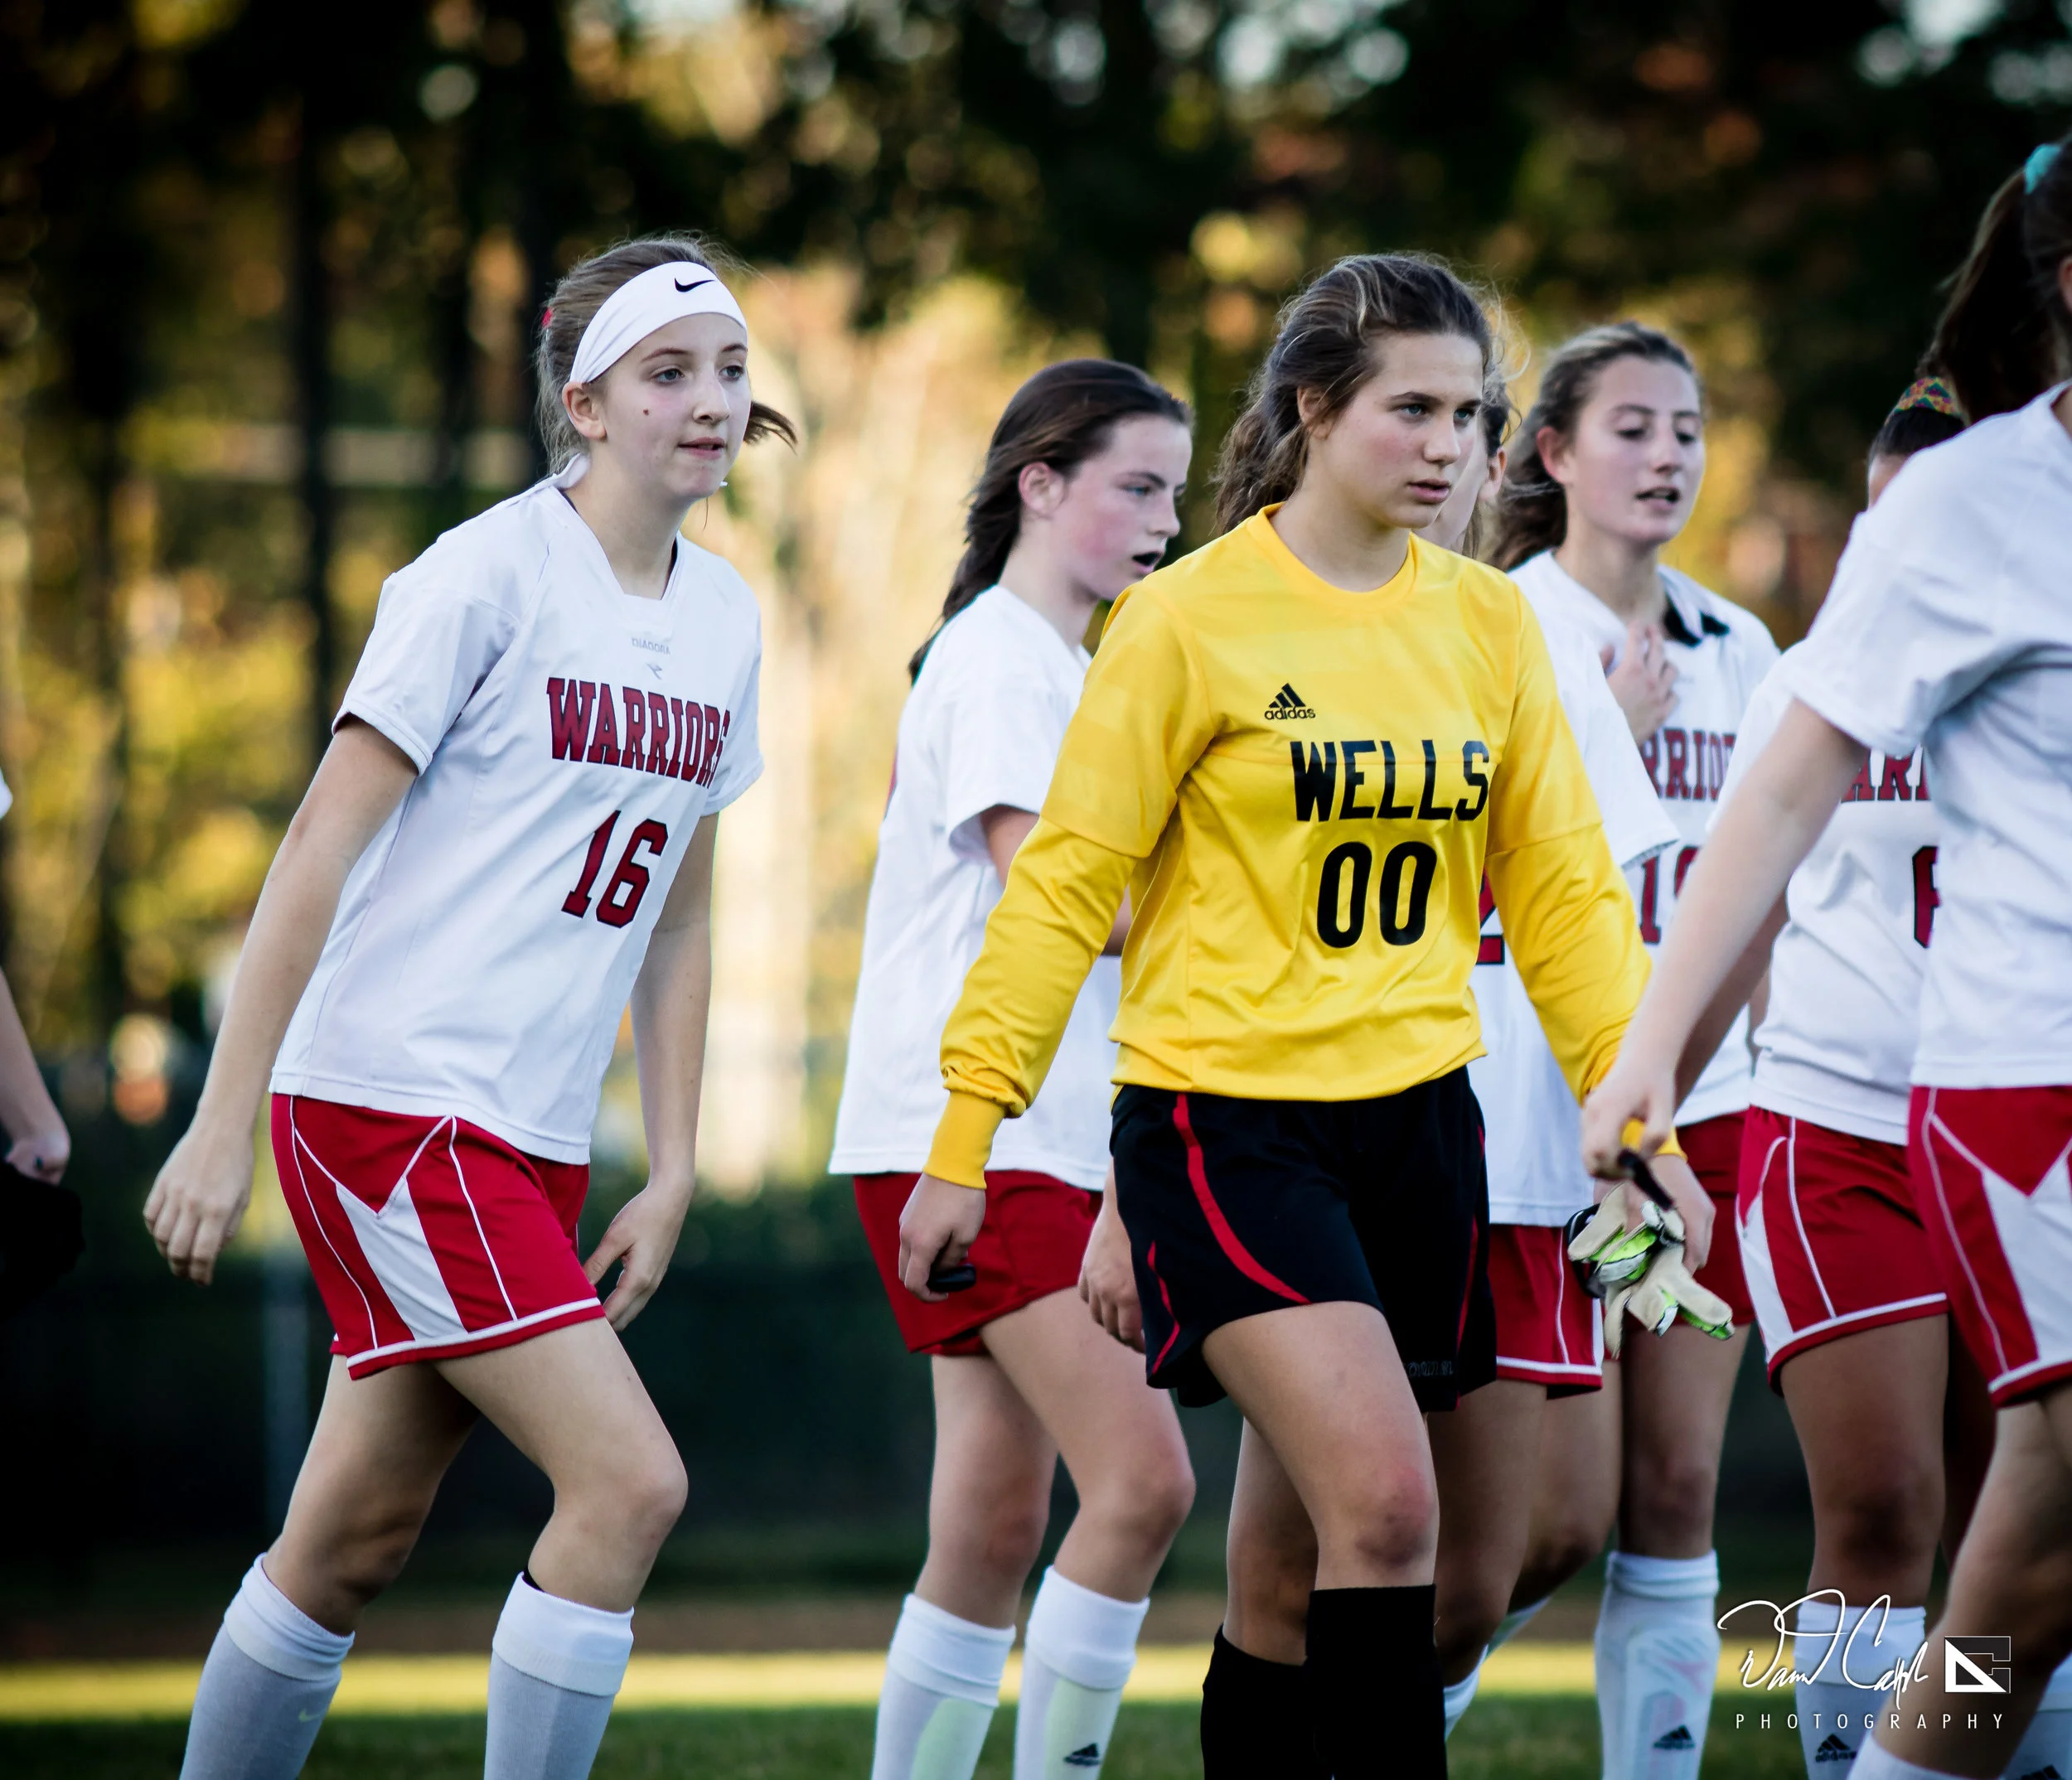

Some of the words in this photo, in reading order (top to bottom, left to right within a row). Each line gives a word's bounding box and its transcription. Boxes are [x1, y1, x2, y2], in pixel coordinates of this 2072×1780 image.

[1264, 707, 1316, 720] adidas
[1290, 739, 1489, 822] WELLS
[561, 810, 669, 929] 16
[1316, 840, 1438, 949] 00
